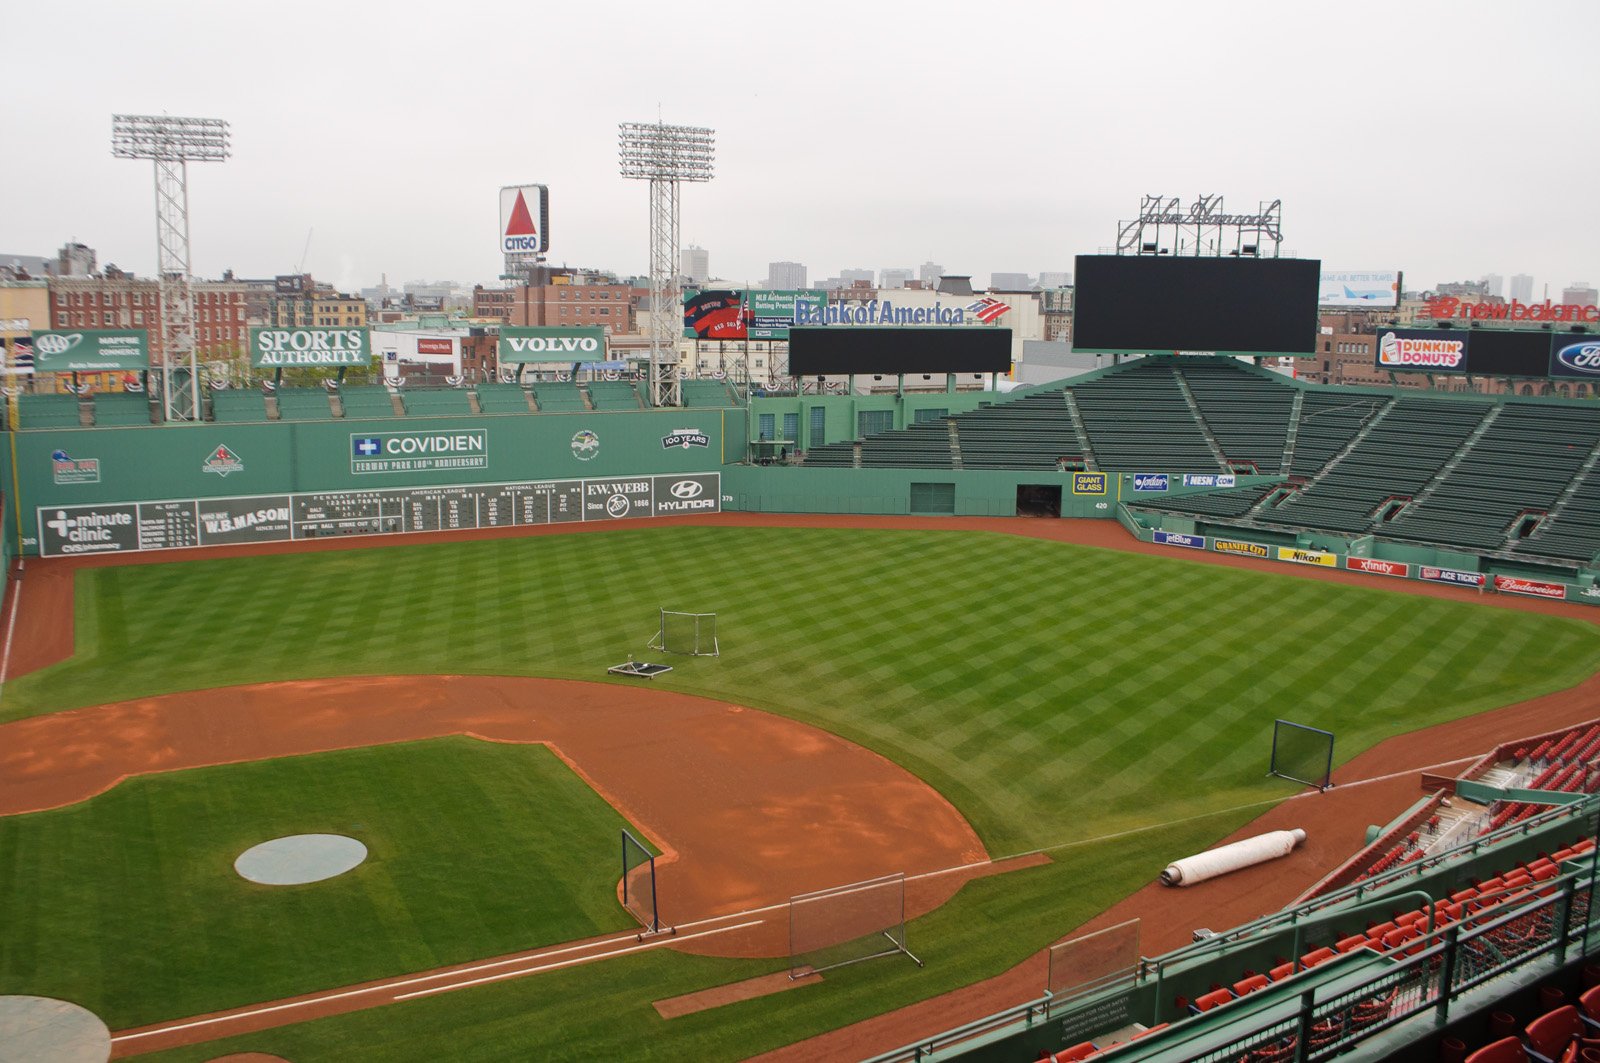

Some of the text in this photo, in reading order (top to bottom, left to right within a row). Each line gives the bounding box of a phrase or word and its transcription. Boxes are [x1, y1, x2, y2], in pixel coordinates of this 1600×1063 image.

[1117, 194, 1283, 249] John Hancock
[505, 237, 536, 250] CITGO
[794, 300, 963, 324] Bank of America
[1461, 299, 1600, 321] new balanc
[714, 323, 724, 331] RED
[258, 330, 362, 350] SPORTS
[506, 338, 598, 351] VOLVO
[1404, 341, 1460, 352] DUNKIN'
[1403, 353, 1457, 365] DONUTS
[387, 436, 482, 454] COVIDIEN
[665, 435, 706, 445] 100 YEARS
[356, 461, 388, 471] FENWAY
[392, 461, 411, 469] PARK
[435, 458, 484, 468] ANNIVERSARY
[1078, 476, 1101, 484] GIANT
[611, 482, 649, 494] WEBB
[587, 502, 603, 510] Since
[634, 499, 649, 507] 1866
[658, 499, 714, 511] HYUNDAI
[76, 512, 132, 527] minute
[68, 527, 112, 541] clinic
[1166, 534, 1191, 545] jetBlue
[1216, 541, 1249, 551] GRANITE
[1292, 551, 1321, 563] Nikon
[1361, 560, 1393, 574] xfinity
[1440, 571, 1456, 580] ACE
[1499, 579, 1563, 595] Budweiser
